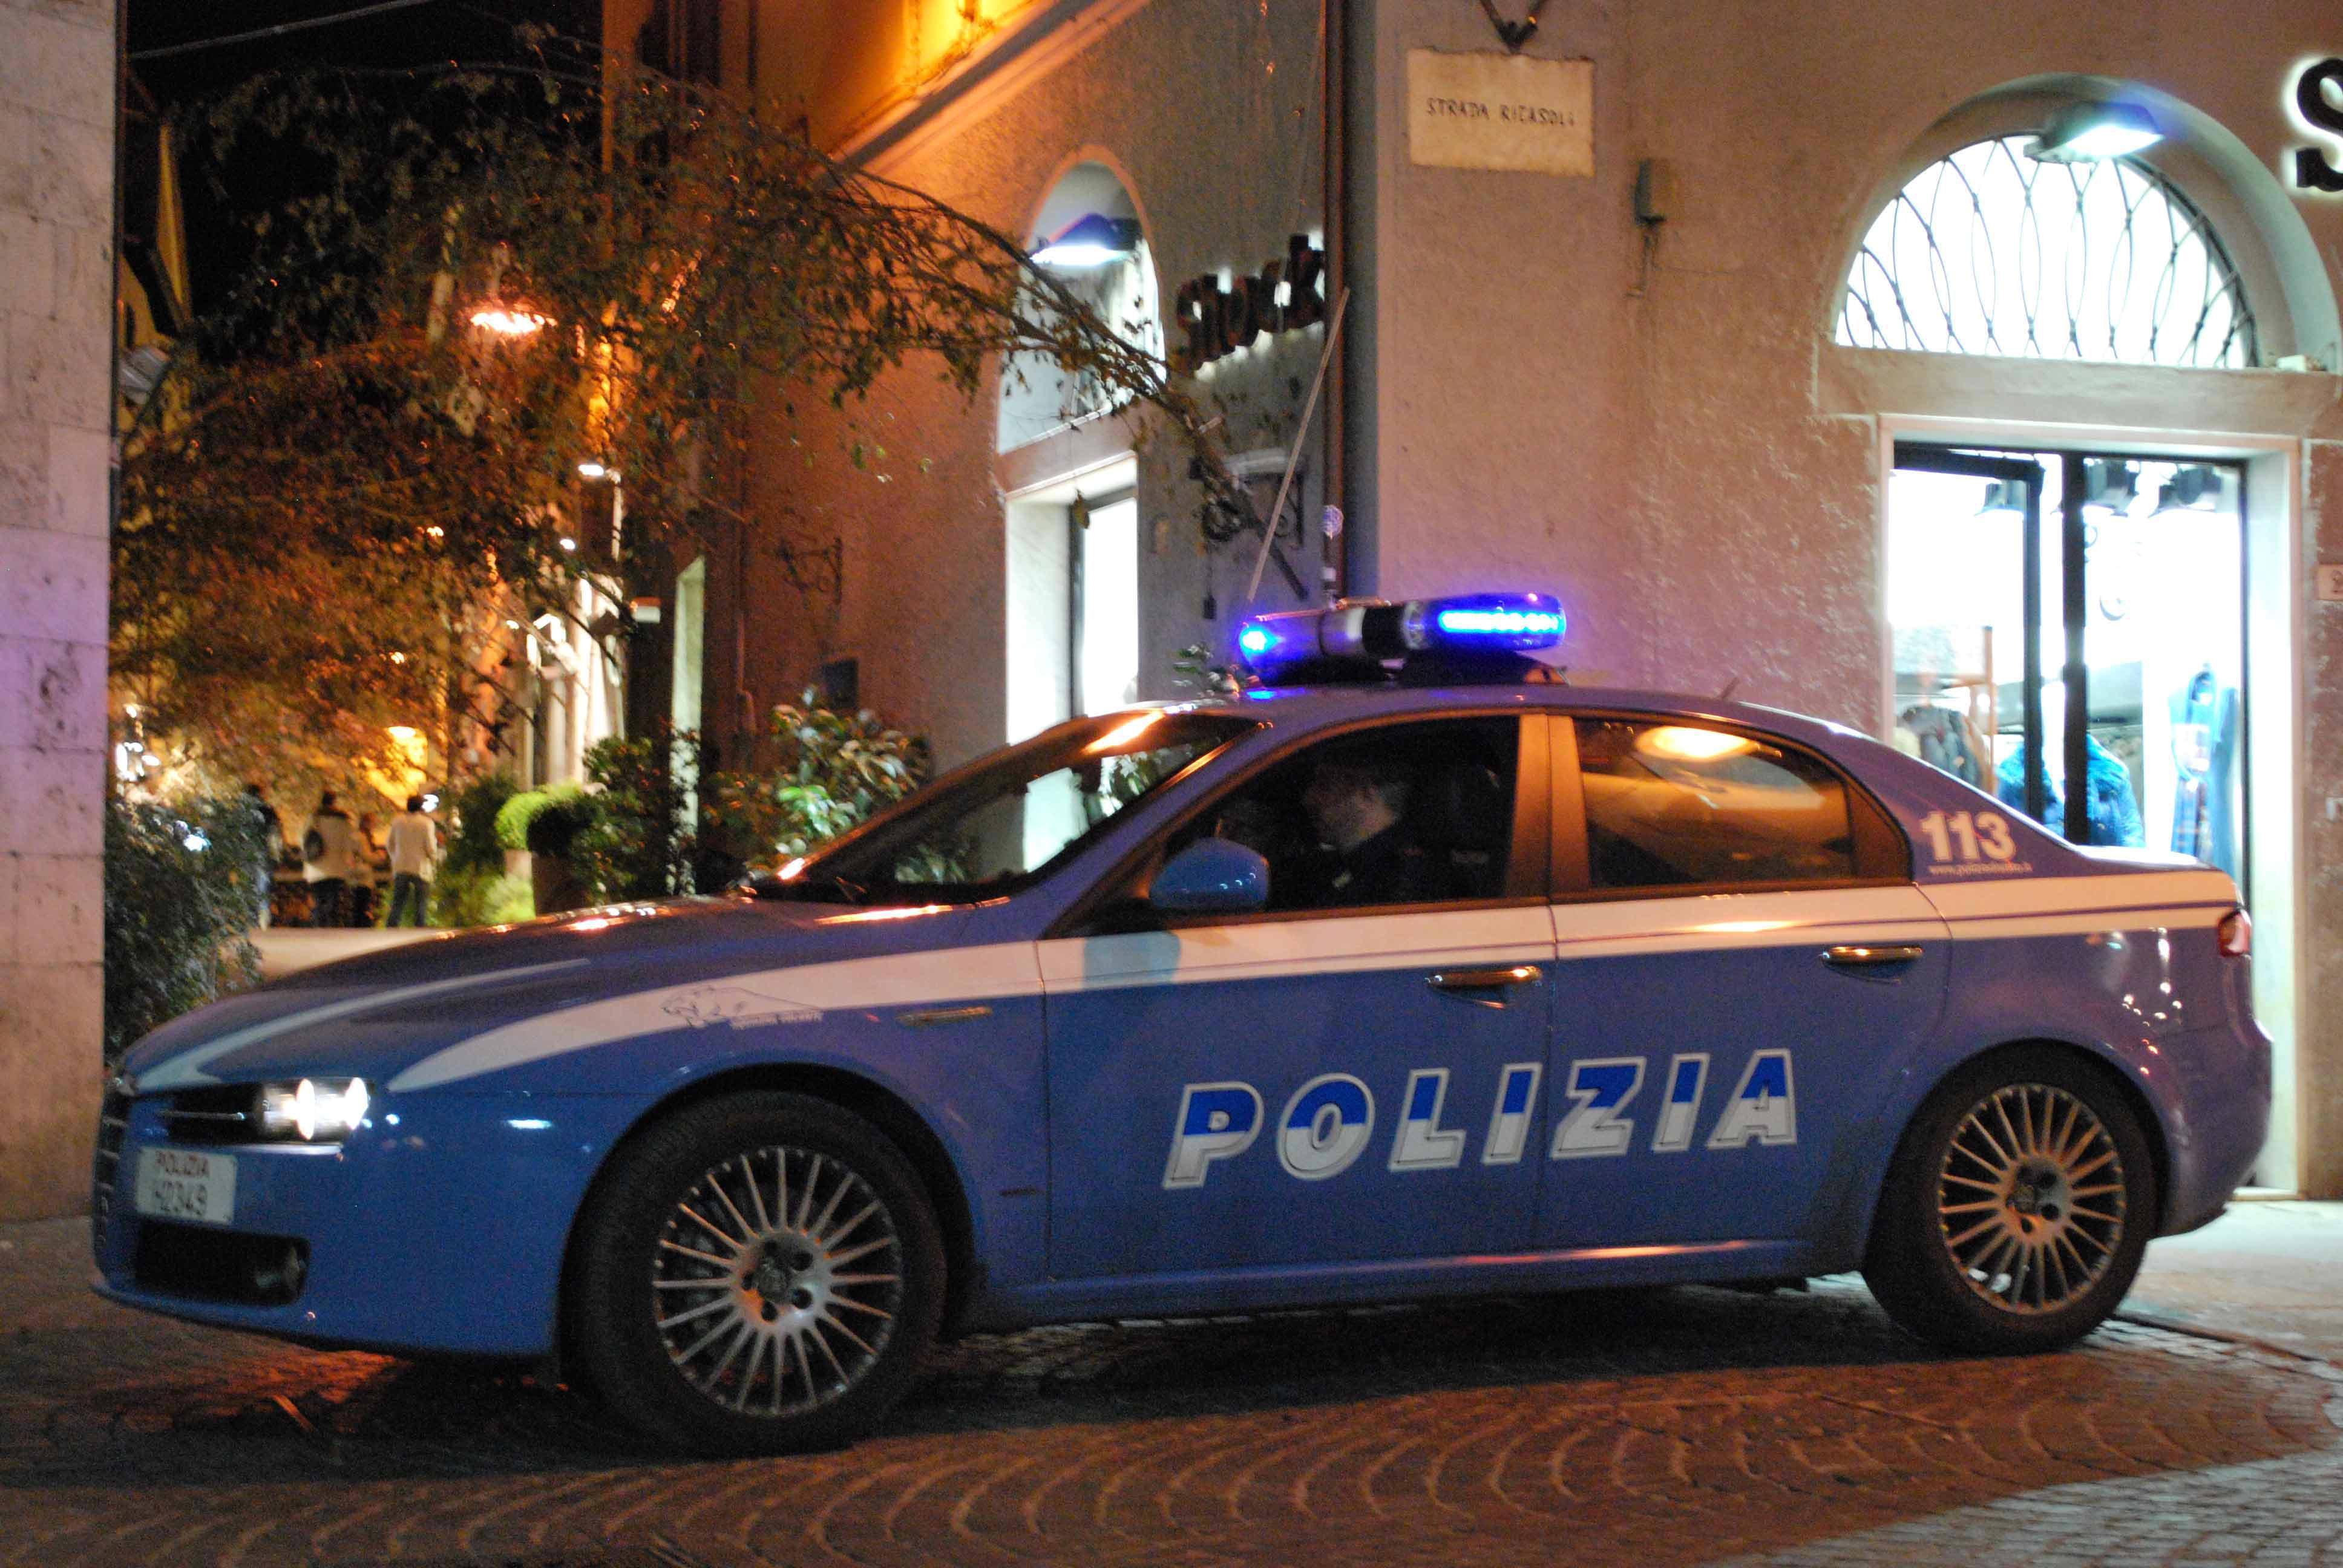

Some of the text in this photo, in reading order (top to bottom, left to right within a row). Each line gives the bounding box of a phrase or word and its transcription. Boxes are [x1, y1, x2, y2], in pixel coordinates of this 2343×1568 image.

[1426, 97, 1489, 119] STRADA
[1919, 810, 2016, 861] 113
[1162, 1048, 1798, 1190] POLIZIA
